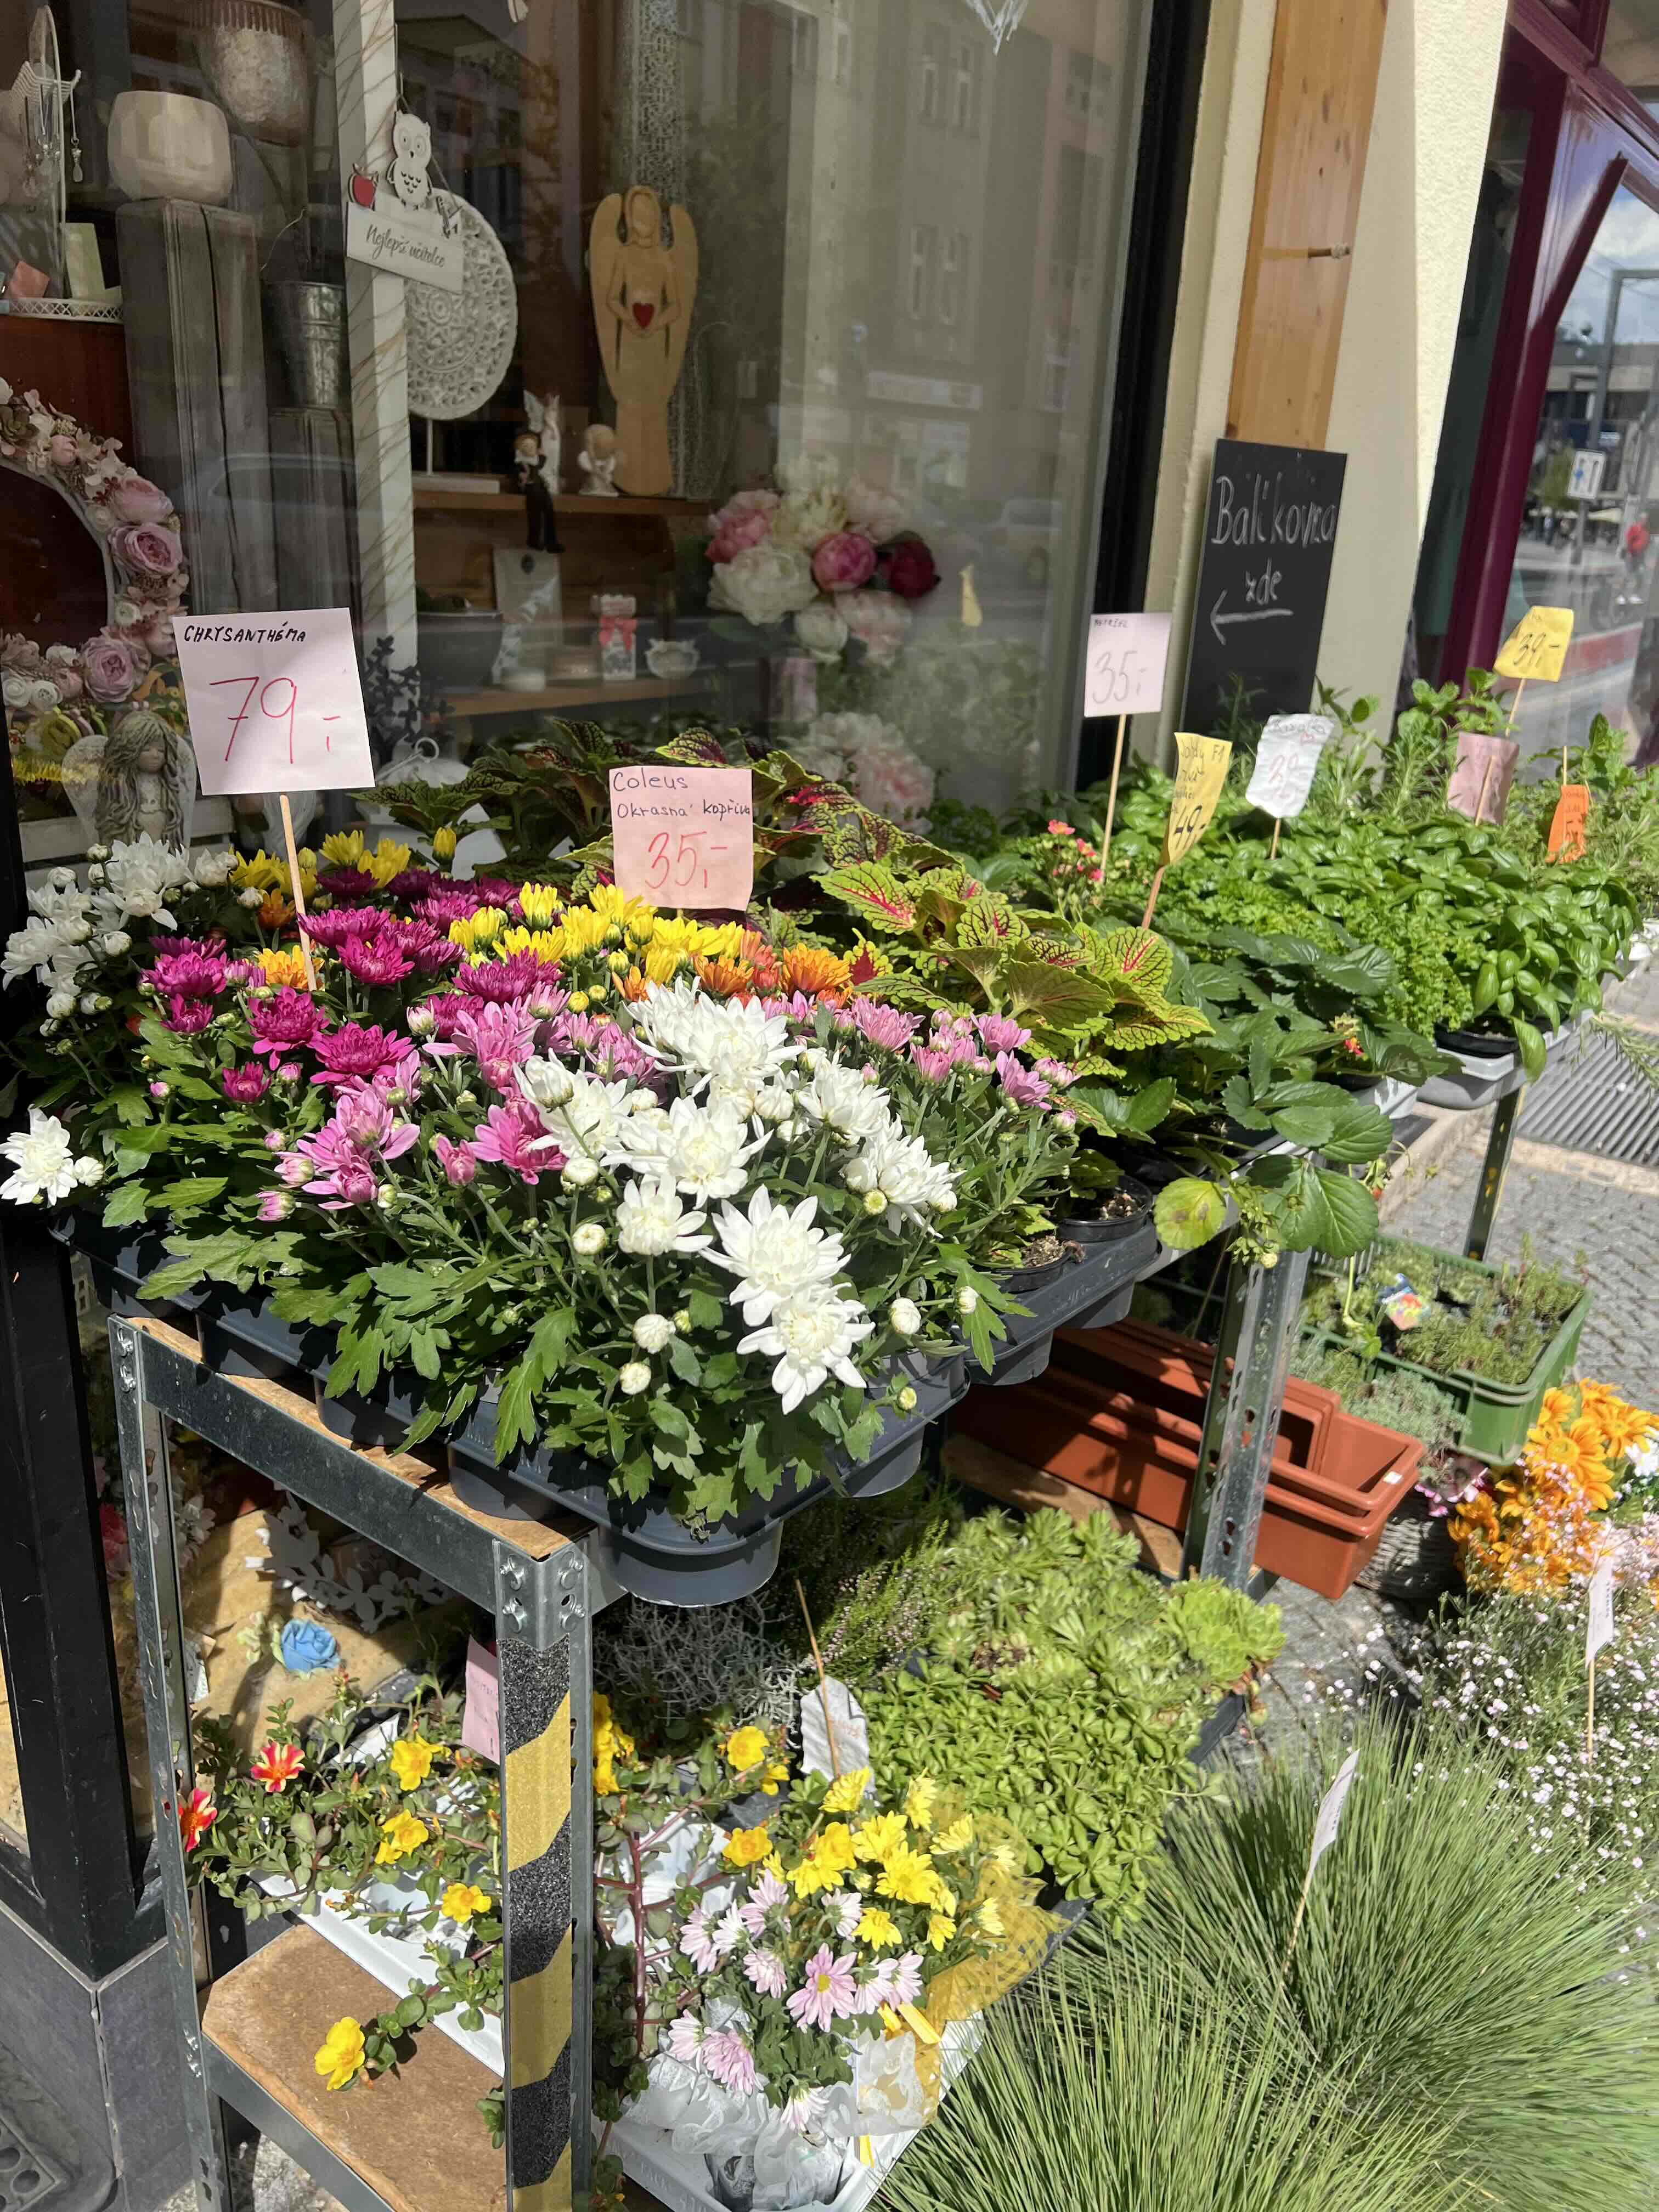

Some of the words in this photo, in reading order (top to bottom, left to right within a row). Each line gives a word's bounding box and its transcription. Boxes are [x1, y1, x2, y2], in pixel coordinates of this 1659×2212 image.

[1245, 558, 1282, 606] zde
[184, 620, 307, 643] CHRYSANTHÉMA
[613, 768, 689, 791] Coleus
